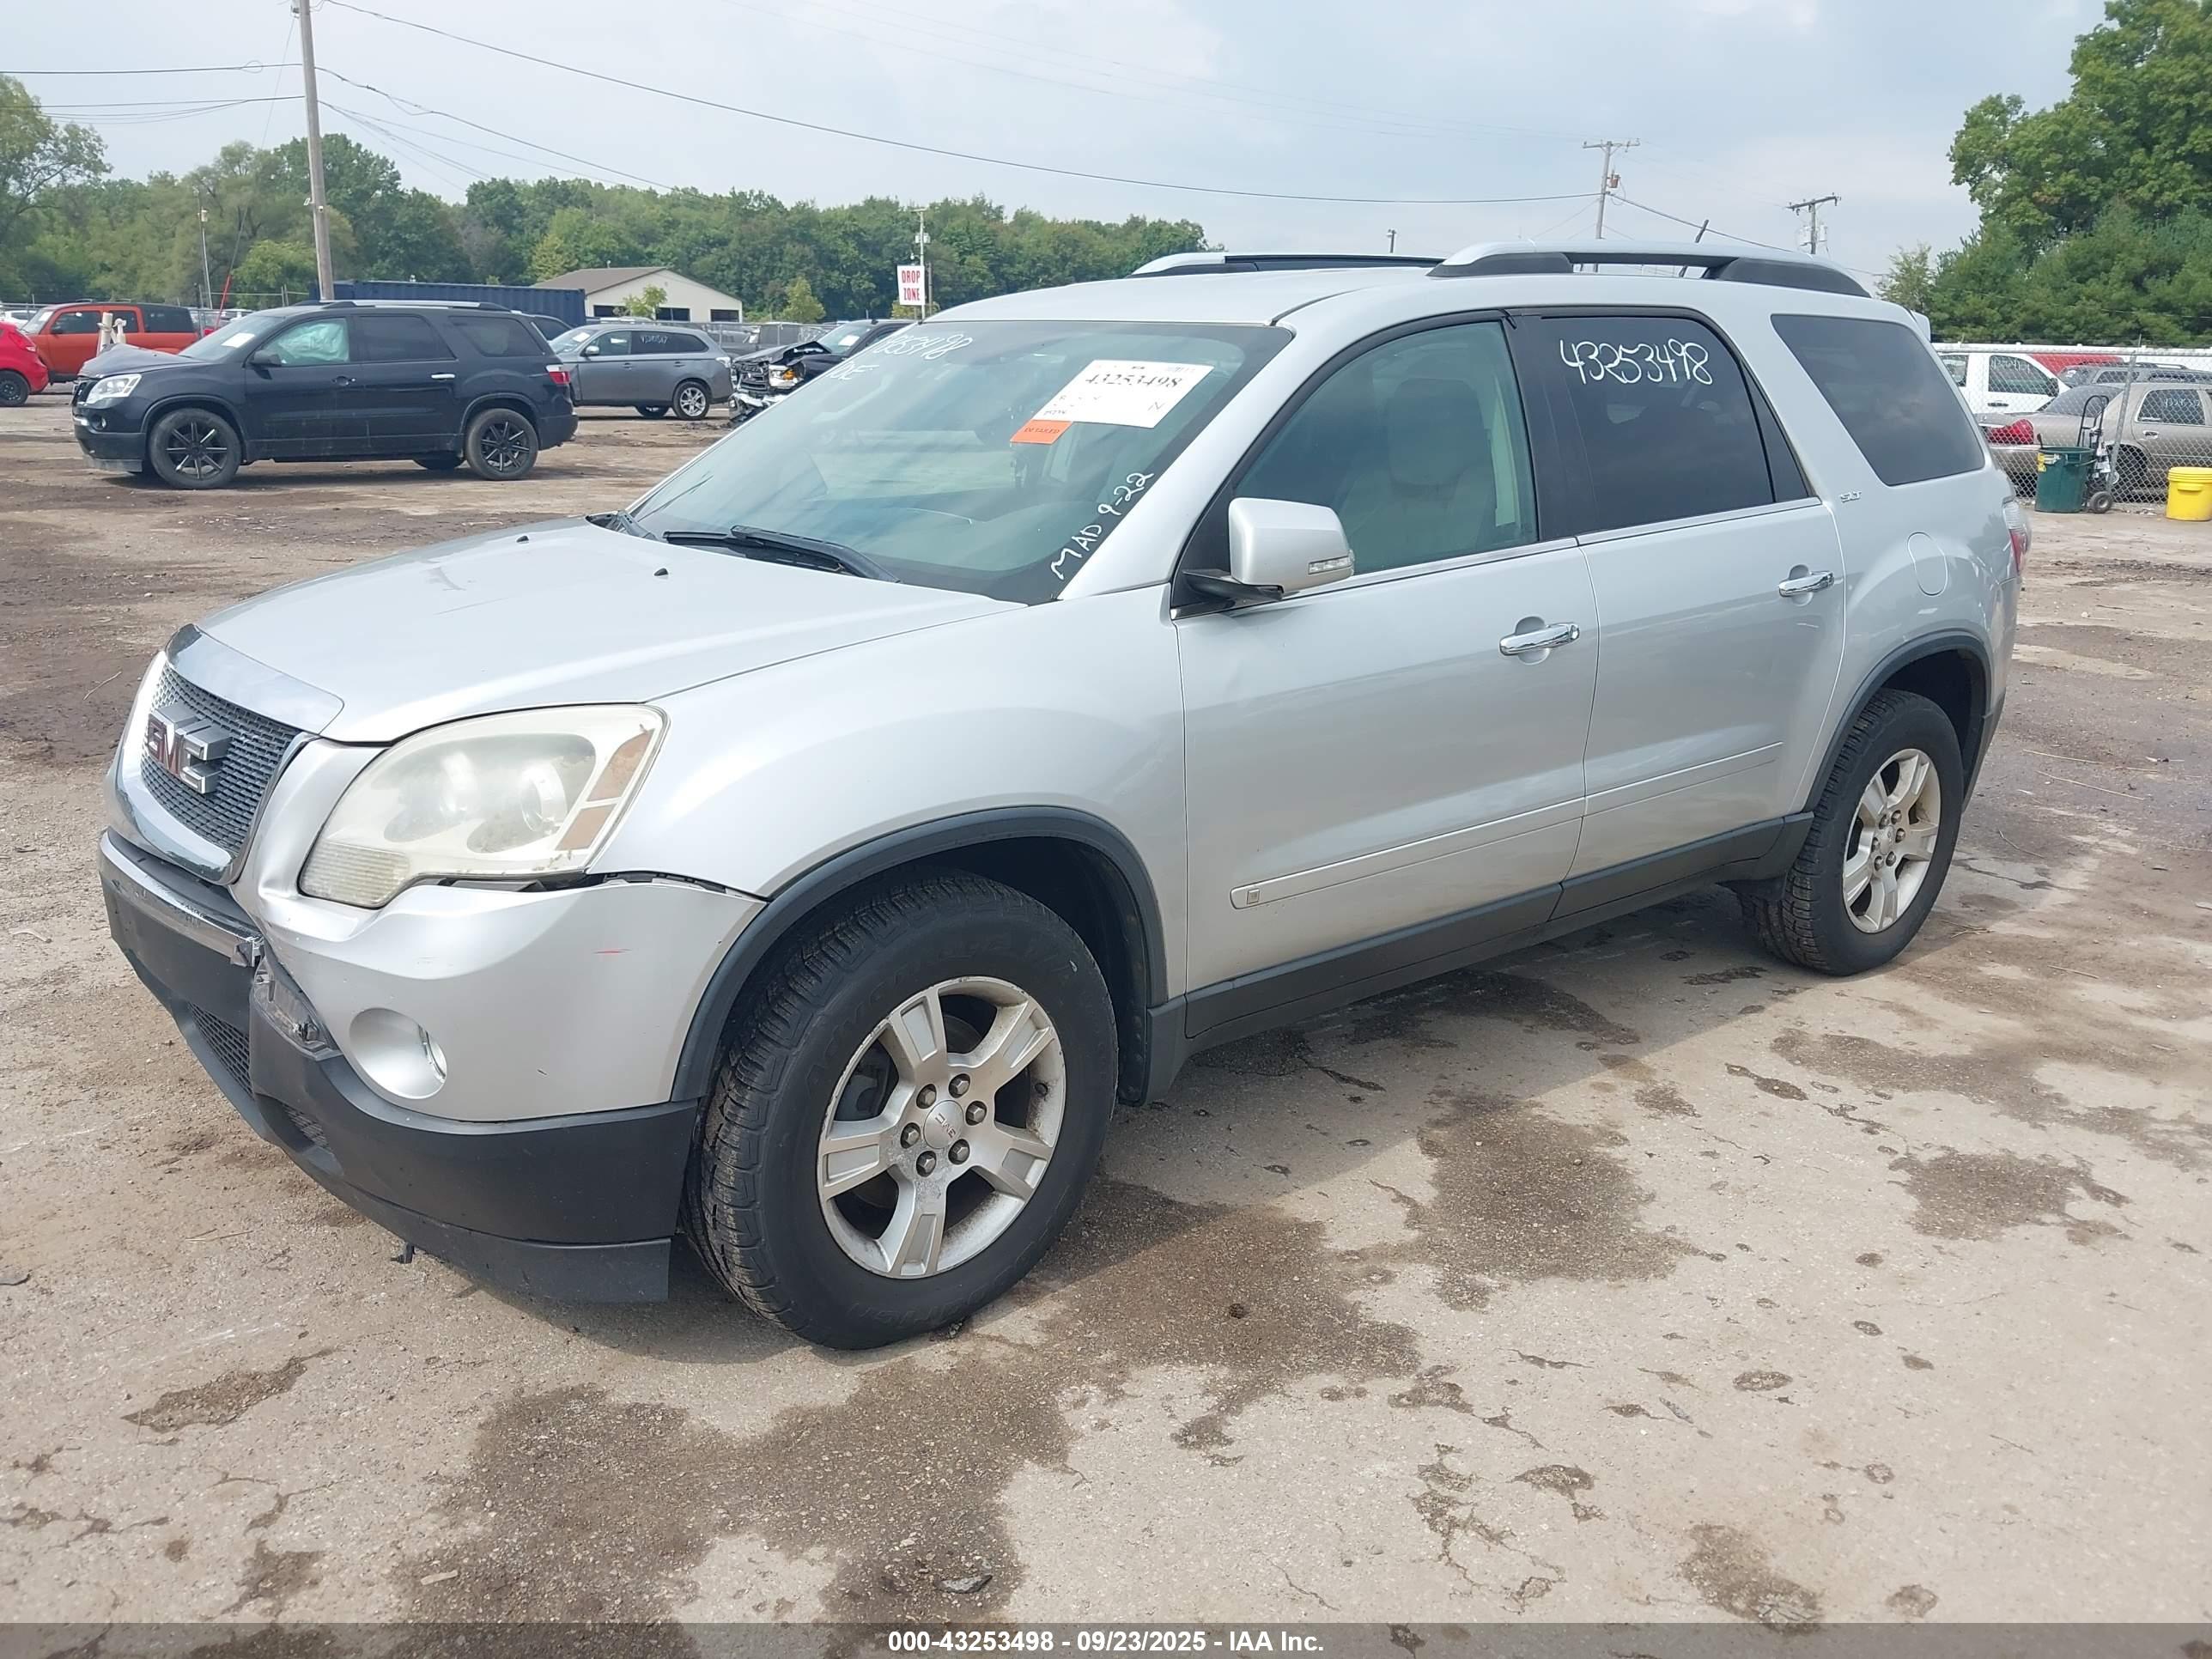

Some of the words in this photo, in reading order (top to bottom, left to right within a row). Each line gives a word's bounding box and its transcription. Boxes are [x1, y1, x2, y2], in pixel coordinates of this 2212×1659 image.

[902, 270, 921, 283] DROP
[903, 288, 921, 301] ZONE
[1559, 338, 1713, 385] 43253498
[1085, 374, 1182, 387] 43253498
[1050, 524, 1103, 580] MAD
[1097, 472, 1155, 516] 9-22
[147, 709, 222, 794] GMC
